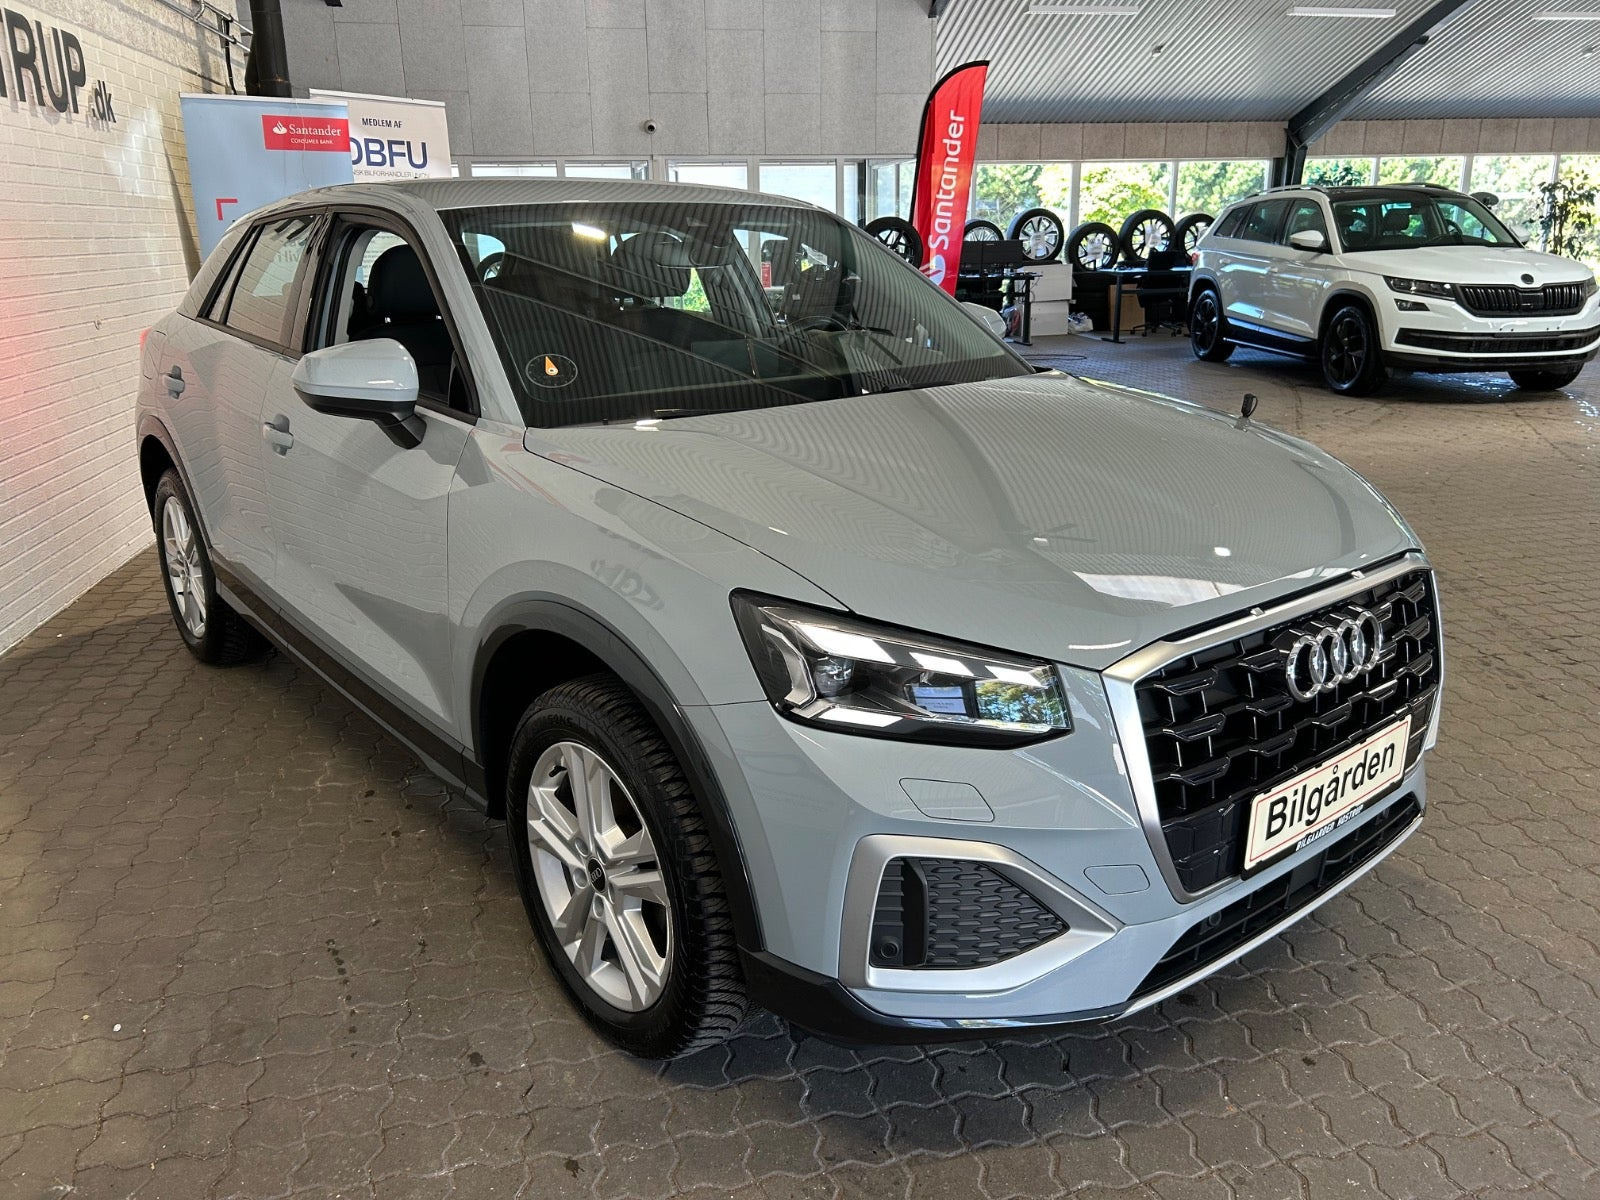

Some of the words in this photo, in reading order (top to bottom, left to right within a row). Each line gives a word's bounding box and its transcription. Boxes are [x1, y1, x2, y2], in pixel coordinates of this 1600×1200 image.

[289, 123, 342, 136] Santander
[362, 118, 392, 128] MEDLEM
[393, 120, 403, 129] AF
[290, 137, 319, 145] CONSUMER
[928, 109, 965, 250] Santander
[1265, 742, 1395, 841] Bilgården
